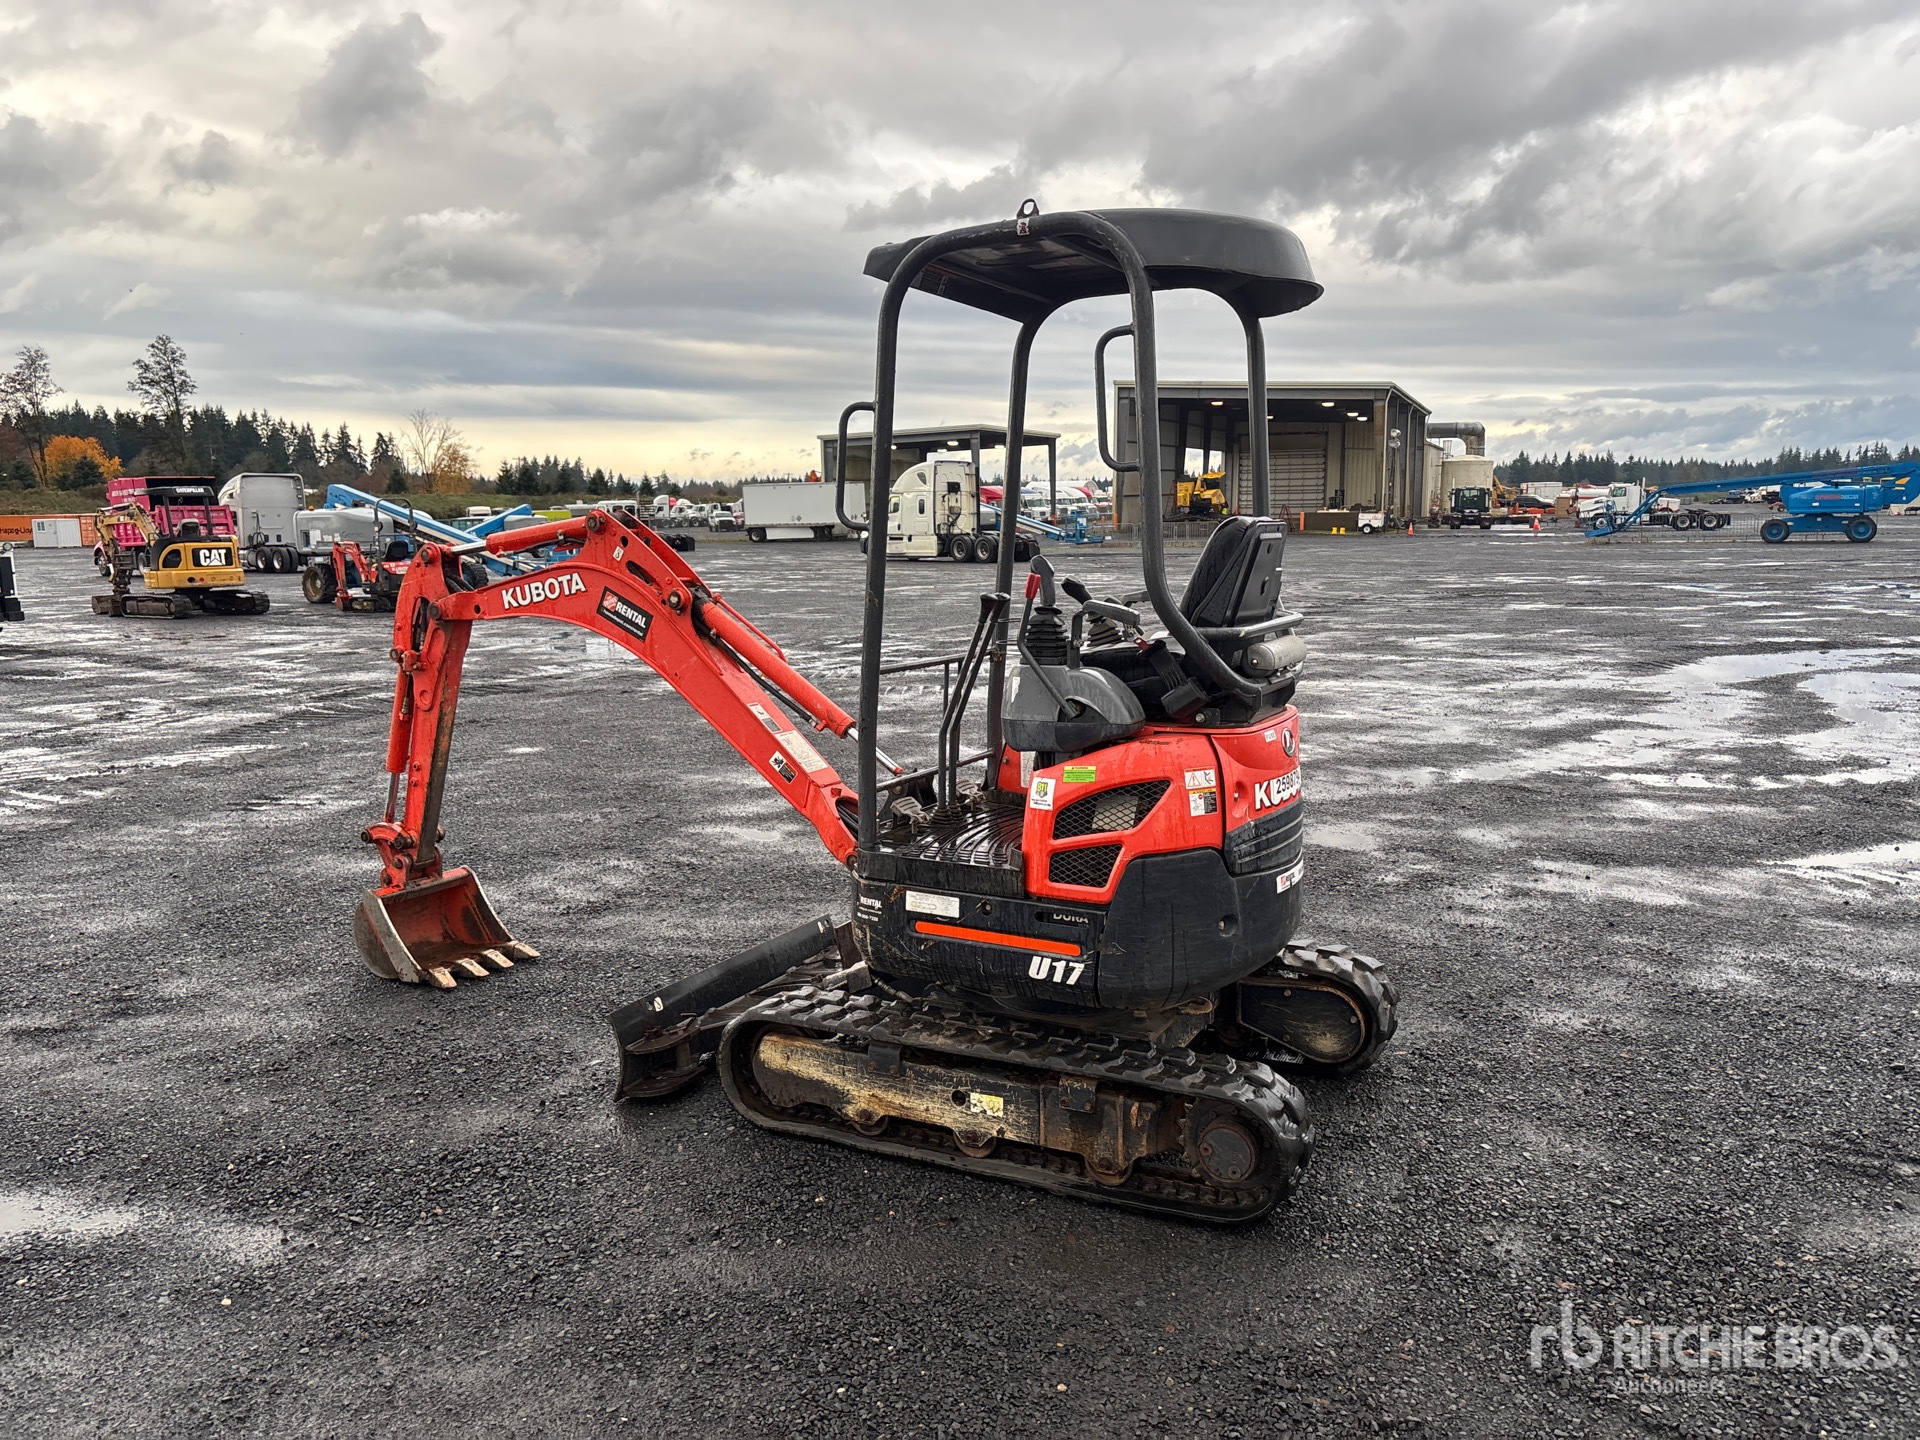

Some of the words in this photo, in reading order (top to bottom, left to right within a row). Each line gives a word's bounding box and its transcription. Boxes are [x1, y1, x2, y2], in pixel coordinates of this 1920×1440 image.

[200, 549, 226, 566] CAT
[501, 572, 586, 610] KUBOTA
[615, 601, 646, 628] RENTAL
[1028, 955, 1085, 985] U17
